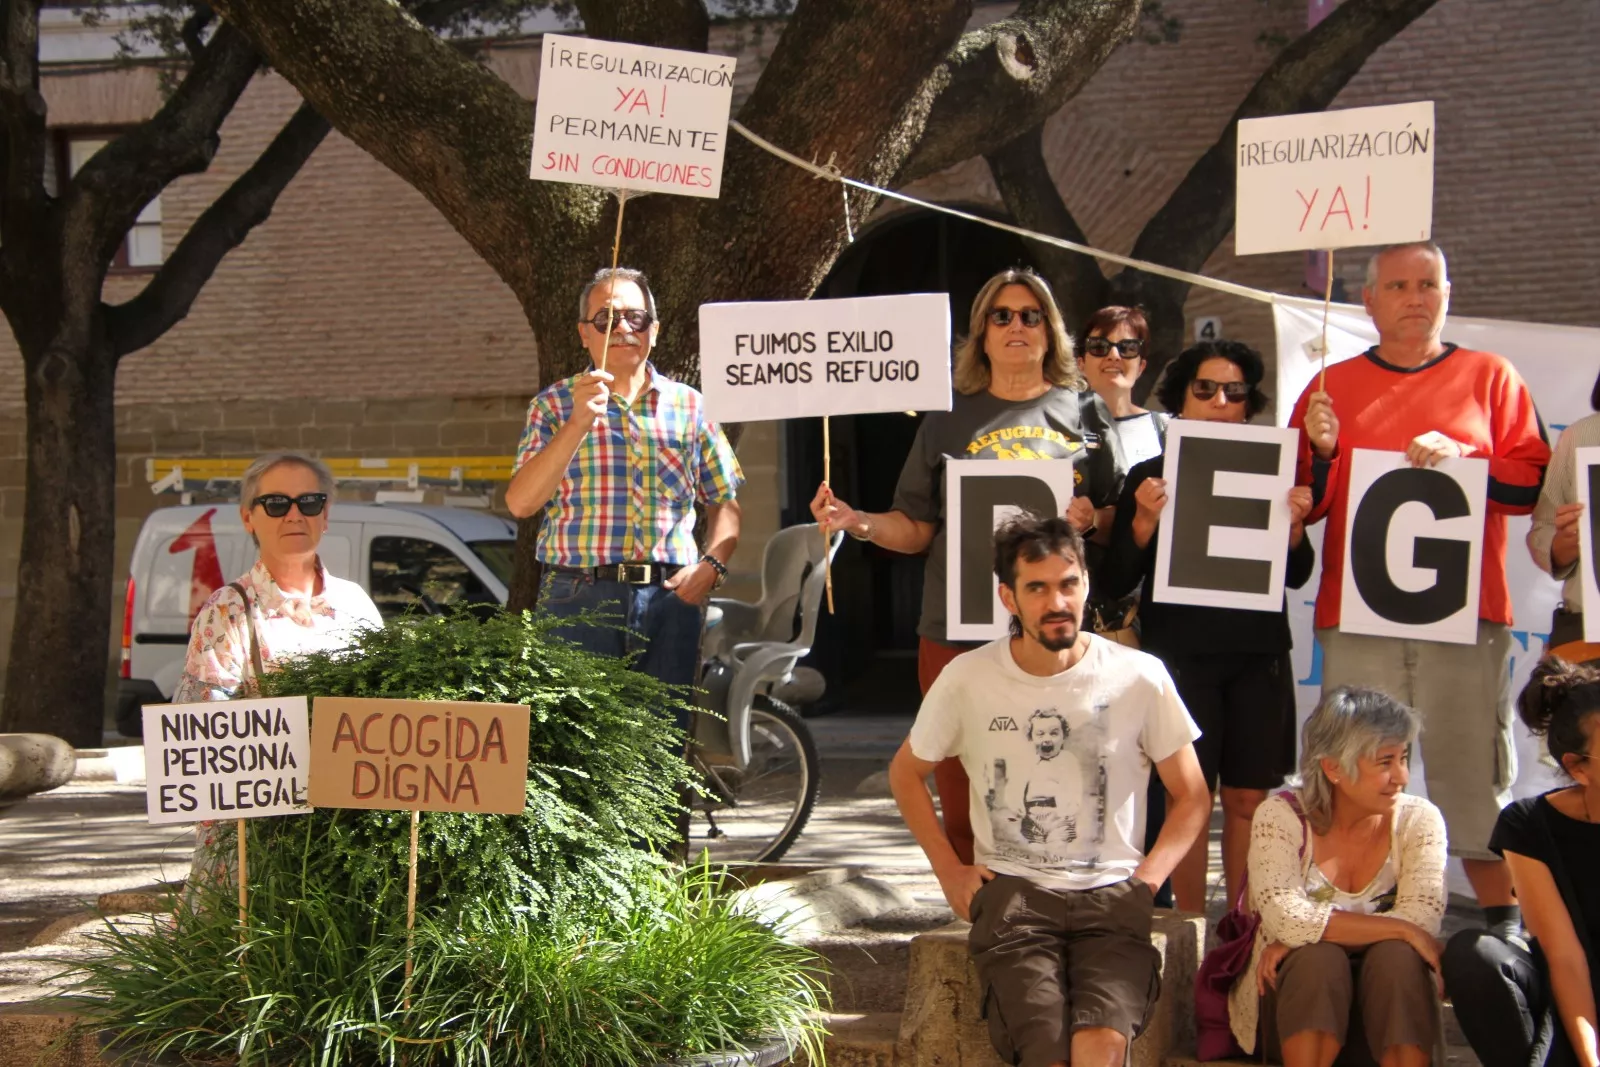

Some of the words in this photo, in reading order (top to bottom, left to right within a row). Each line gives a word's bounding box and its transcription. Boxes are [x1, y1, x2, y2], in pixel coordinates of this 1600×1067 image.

[550, 42, 735, 87] ¡REGULARIZACIÓN
[614, 85, 667, 118] YA!
[550, 115, 718, 152] PERMANENTE
[1240, 122, 1430, 167] ¡REGULARIZACIÓN
[542, 151, 579, 173] SIN
[592, 154, 713, 188] CONDICIONES
[1296, 175, 1370, 232] YA!
[735, 331, 817, 356] FUIMOS
[827, 330, 894, 354] EXILIO
[1201, 320, 1216, 340] 4
[726, 361, 813, 386] SEAMOS
[826, 360, 919, 383] REFUGIO
[1168, 435, 1283, 596] E
[1351, 467, 1472, 625] G
[161, 708, 291, 742] NINGUNA
[164, 742, 297, 777] PERSONA
[160, 783, 198, 813] ES
[210, 777, 308, 811] ILEGAL
